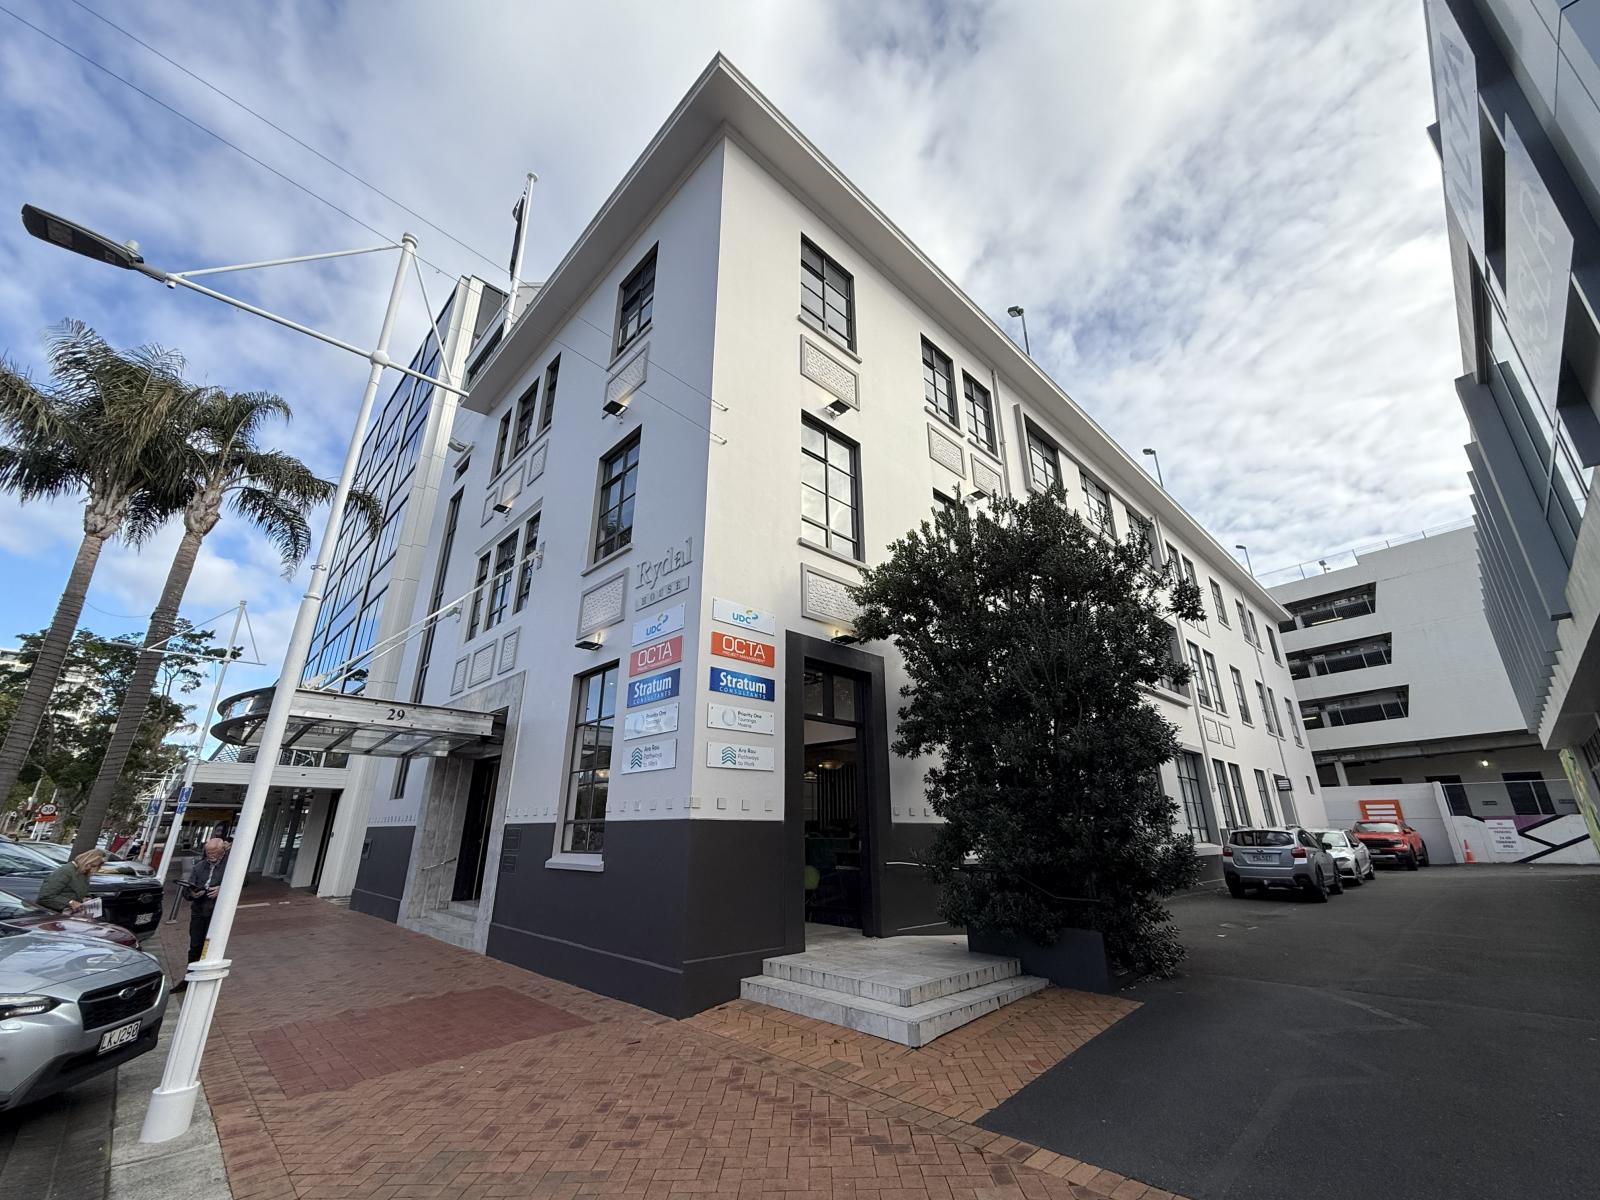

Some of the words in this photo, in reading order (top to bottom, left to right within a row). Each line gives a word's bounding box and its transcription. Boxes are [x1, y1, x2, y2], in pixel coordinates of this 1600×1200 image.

[636, 536, 693, 589] Rydal
[641, 581, 682, 604] HOUSE
[732, 612, 751, 624] UDC
[646, 622, 661, 636] UDC
[638, 640, 672, 667] OCTA
[722, 636, 765, 659] OCTA
[634, 677, 672, 698] Stratum
[720, 672, 766, 693] Stratum
[720, 687, 765, 699] CONSULTANTS
[633, 690, 671, 704] CONSULTANTS
[387, 708, 405, 720] 29
[101, 1023, 139, 1050] LKJ298
